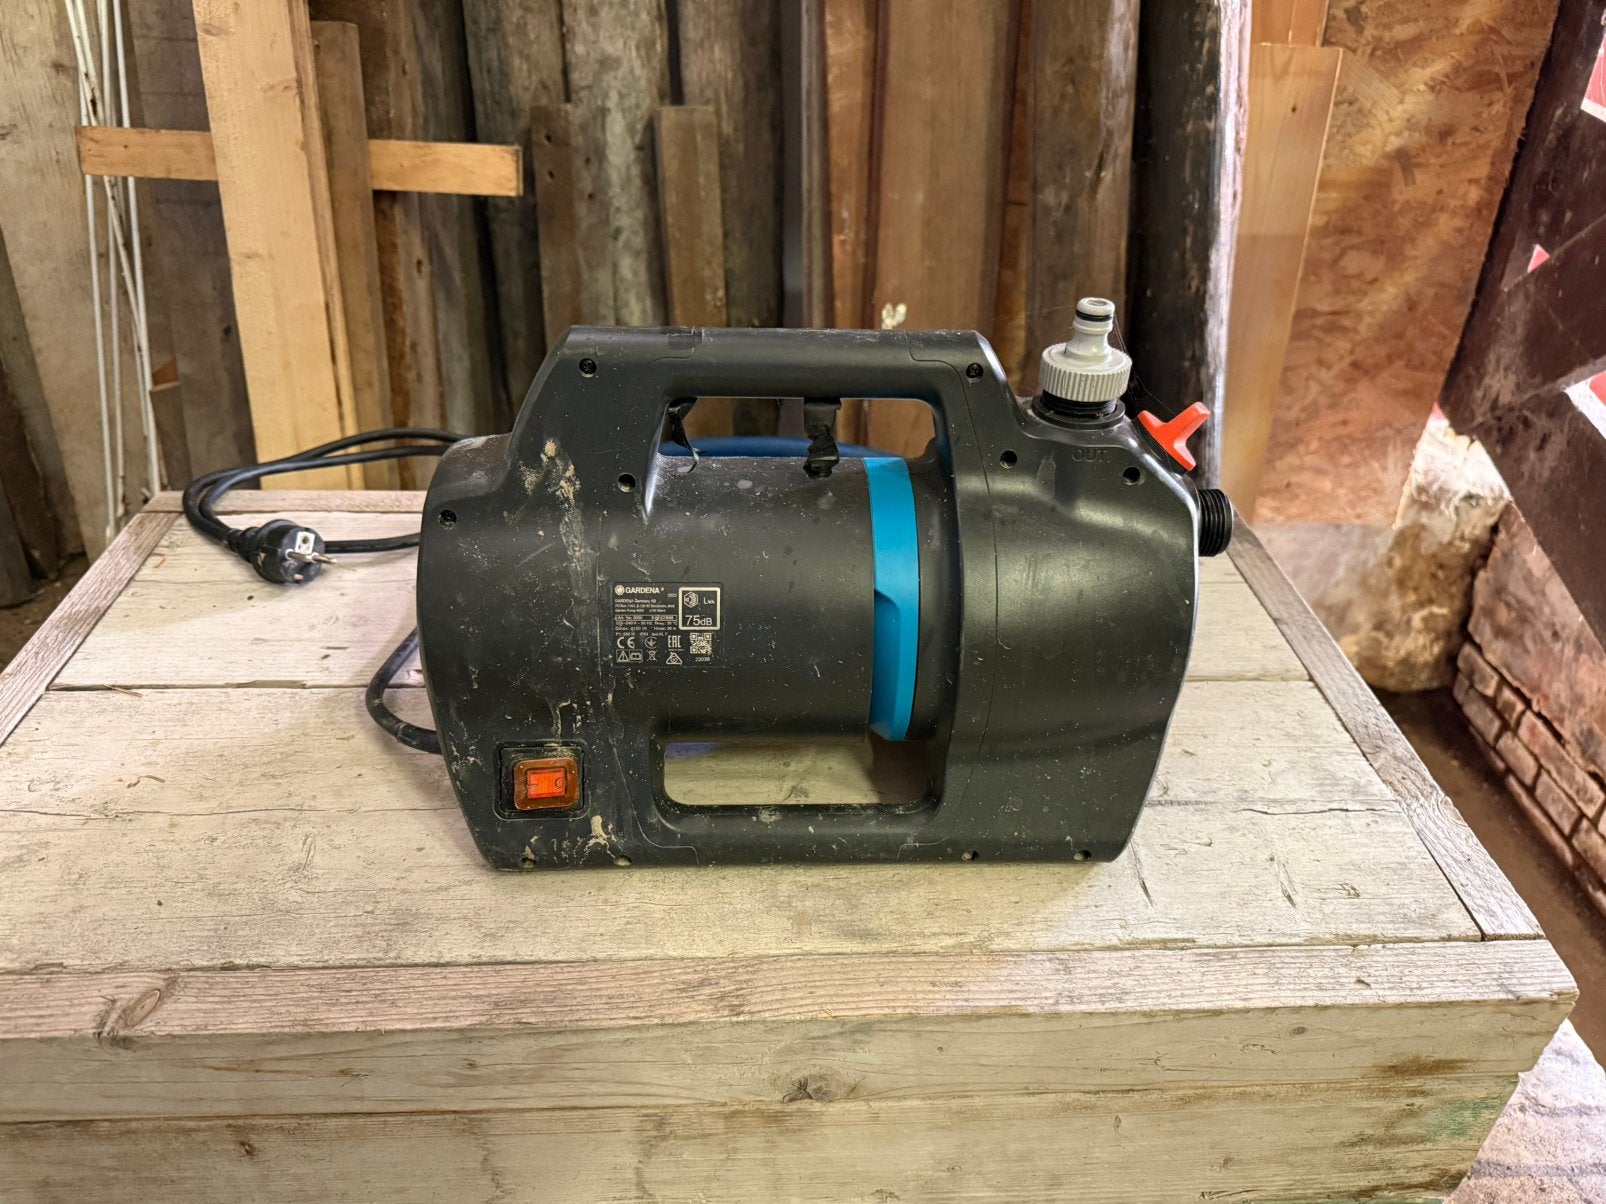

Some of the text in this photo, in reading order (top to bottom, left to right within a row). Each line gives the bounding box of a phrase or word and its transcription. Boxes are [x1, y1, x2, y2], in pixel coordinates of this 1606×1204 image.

[1071, 449, 1107, 462] OUT
[625, 586, 660, 594] GARDENA
[685, 614, 713, 626] 75dB
